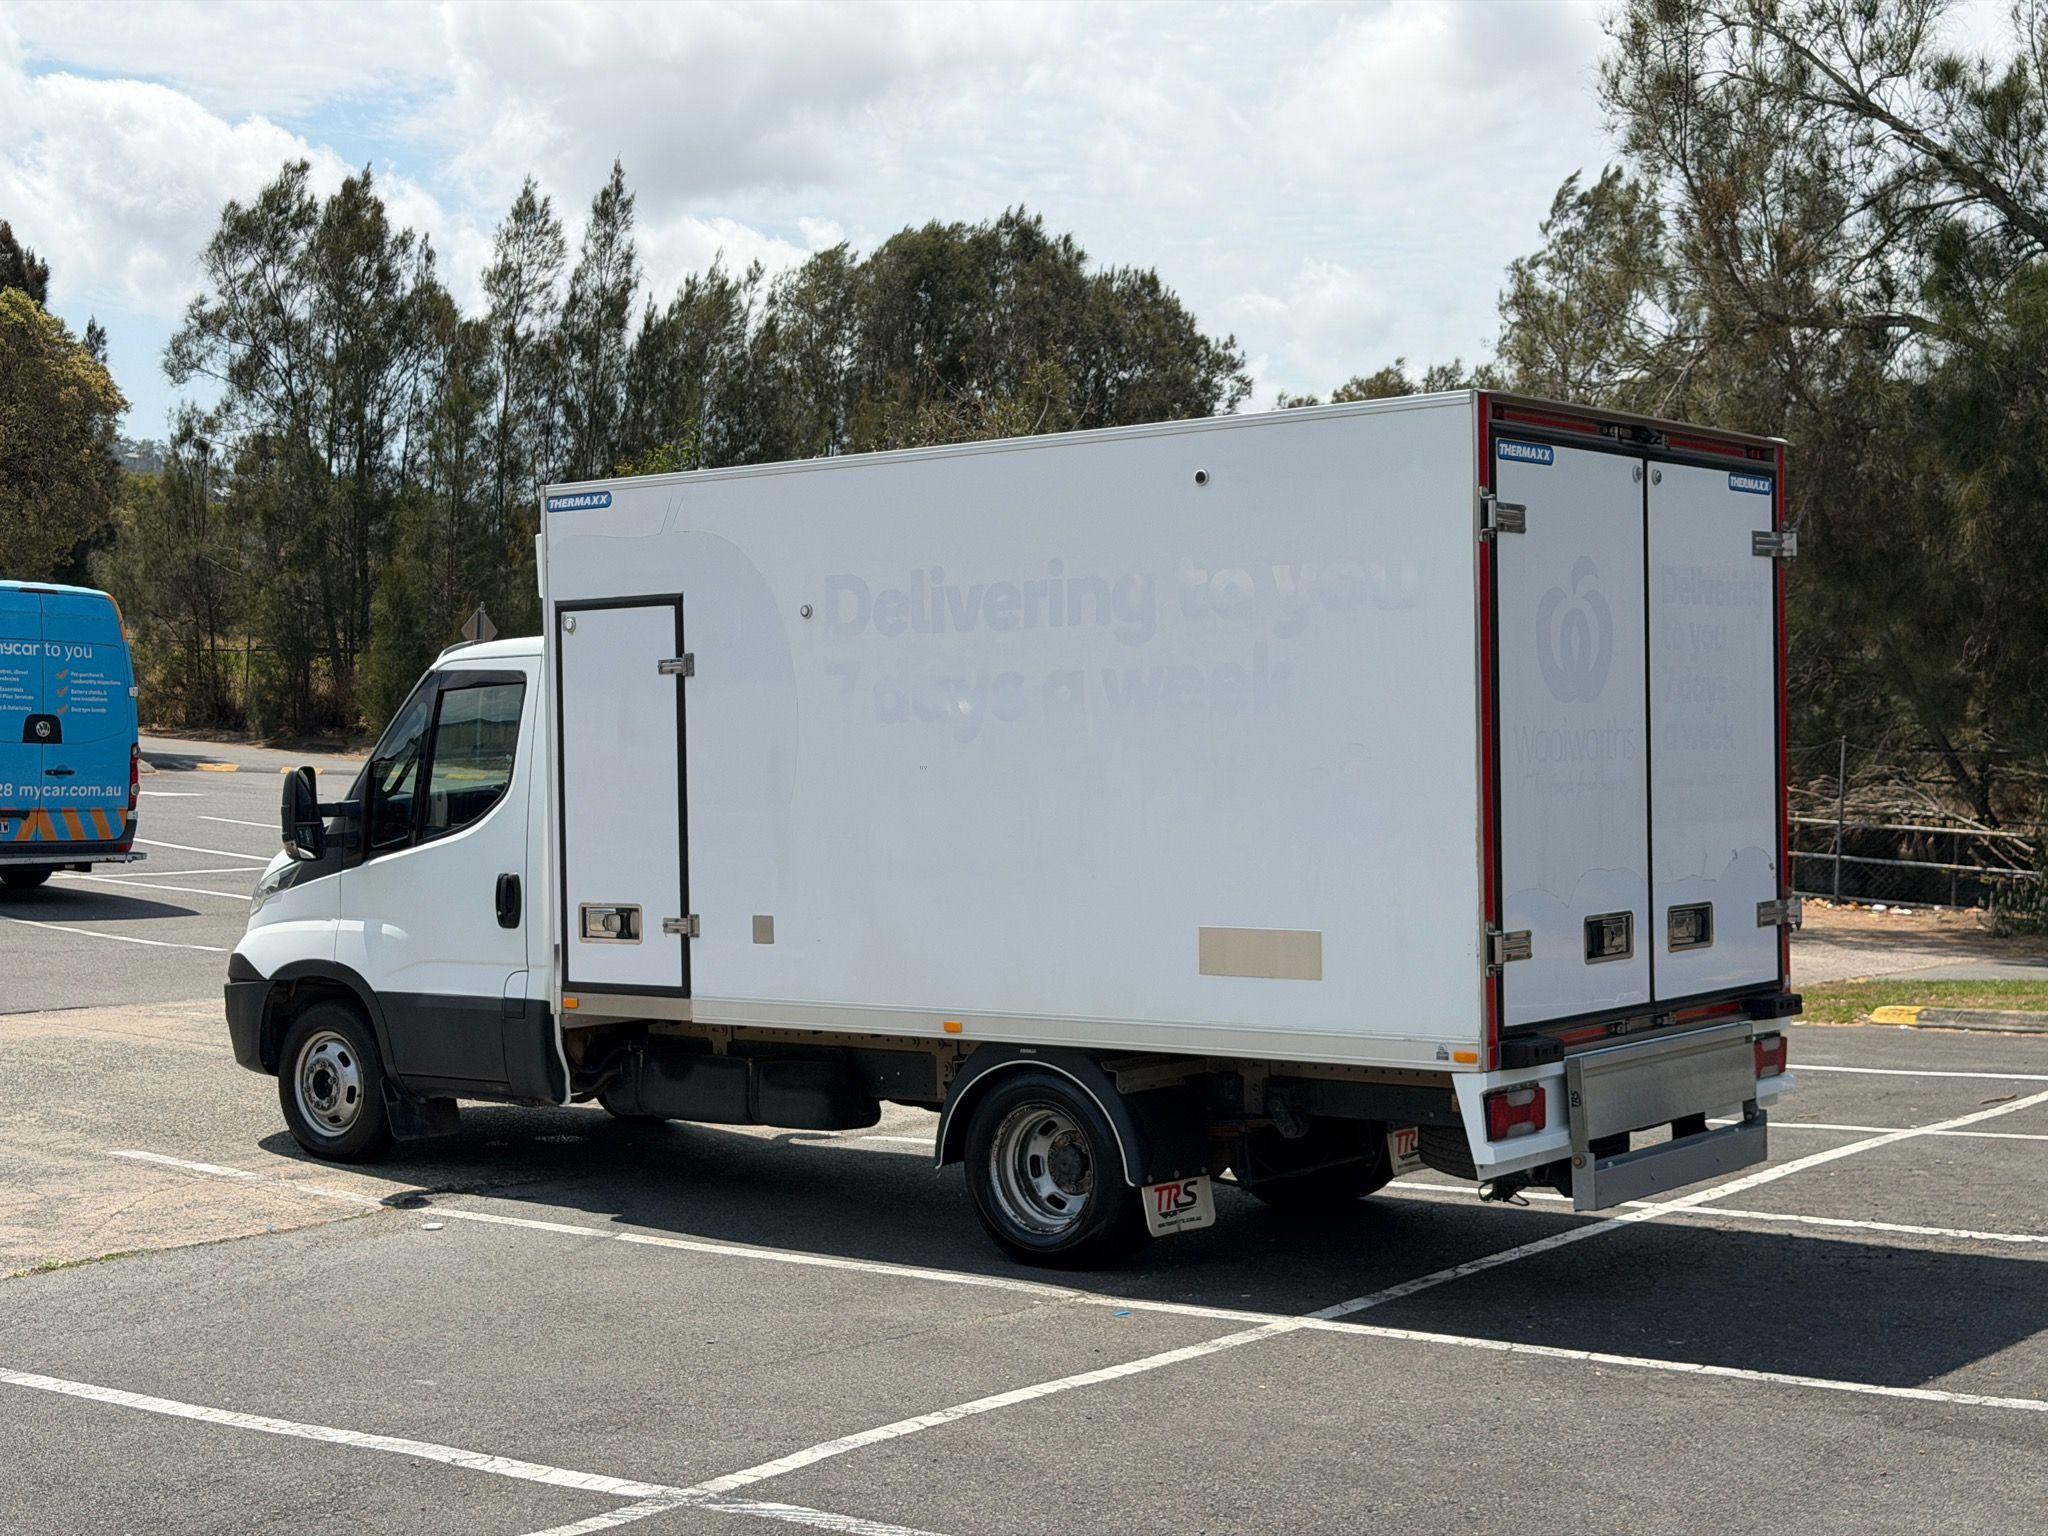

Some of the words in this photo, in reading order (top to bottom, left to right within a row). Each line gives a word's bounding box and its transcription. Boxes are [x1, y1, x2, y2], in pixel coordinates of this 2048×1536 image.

[1499, 443, 1551, 461] THERMAXX
[1730, 476, 1770, 491] THERMAXX
[548, 494, 608, 509] THERMAXX
[823, 557, 1158, 646] Delivering
[1177, 556, 1255, 620] to
[1271, 560, 1418, 638] you
[0, 643, 40, 655] ycar
[44, 642, 61, 657] to
[65, 645, 93, 661] you
[19, 784, 122, 800] mycar.com.au
[1154, 1180, 1198, 1213] TRS
